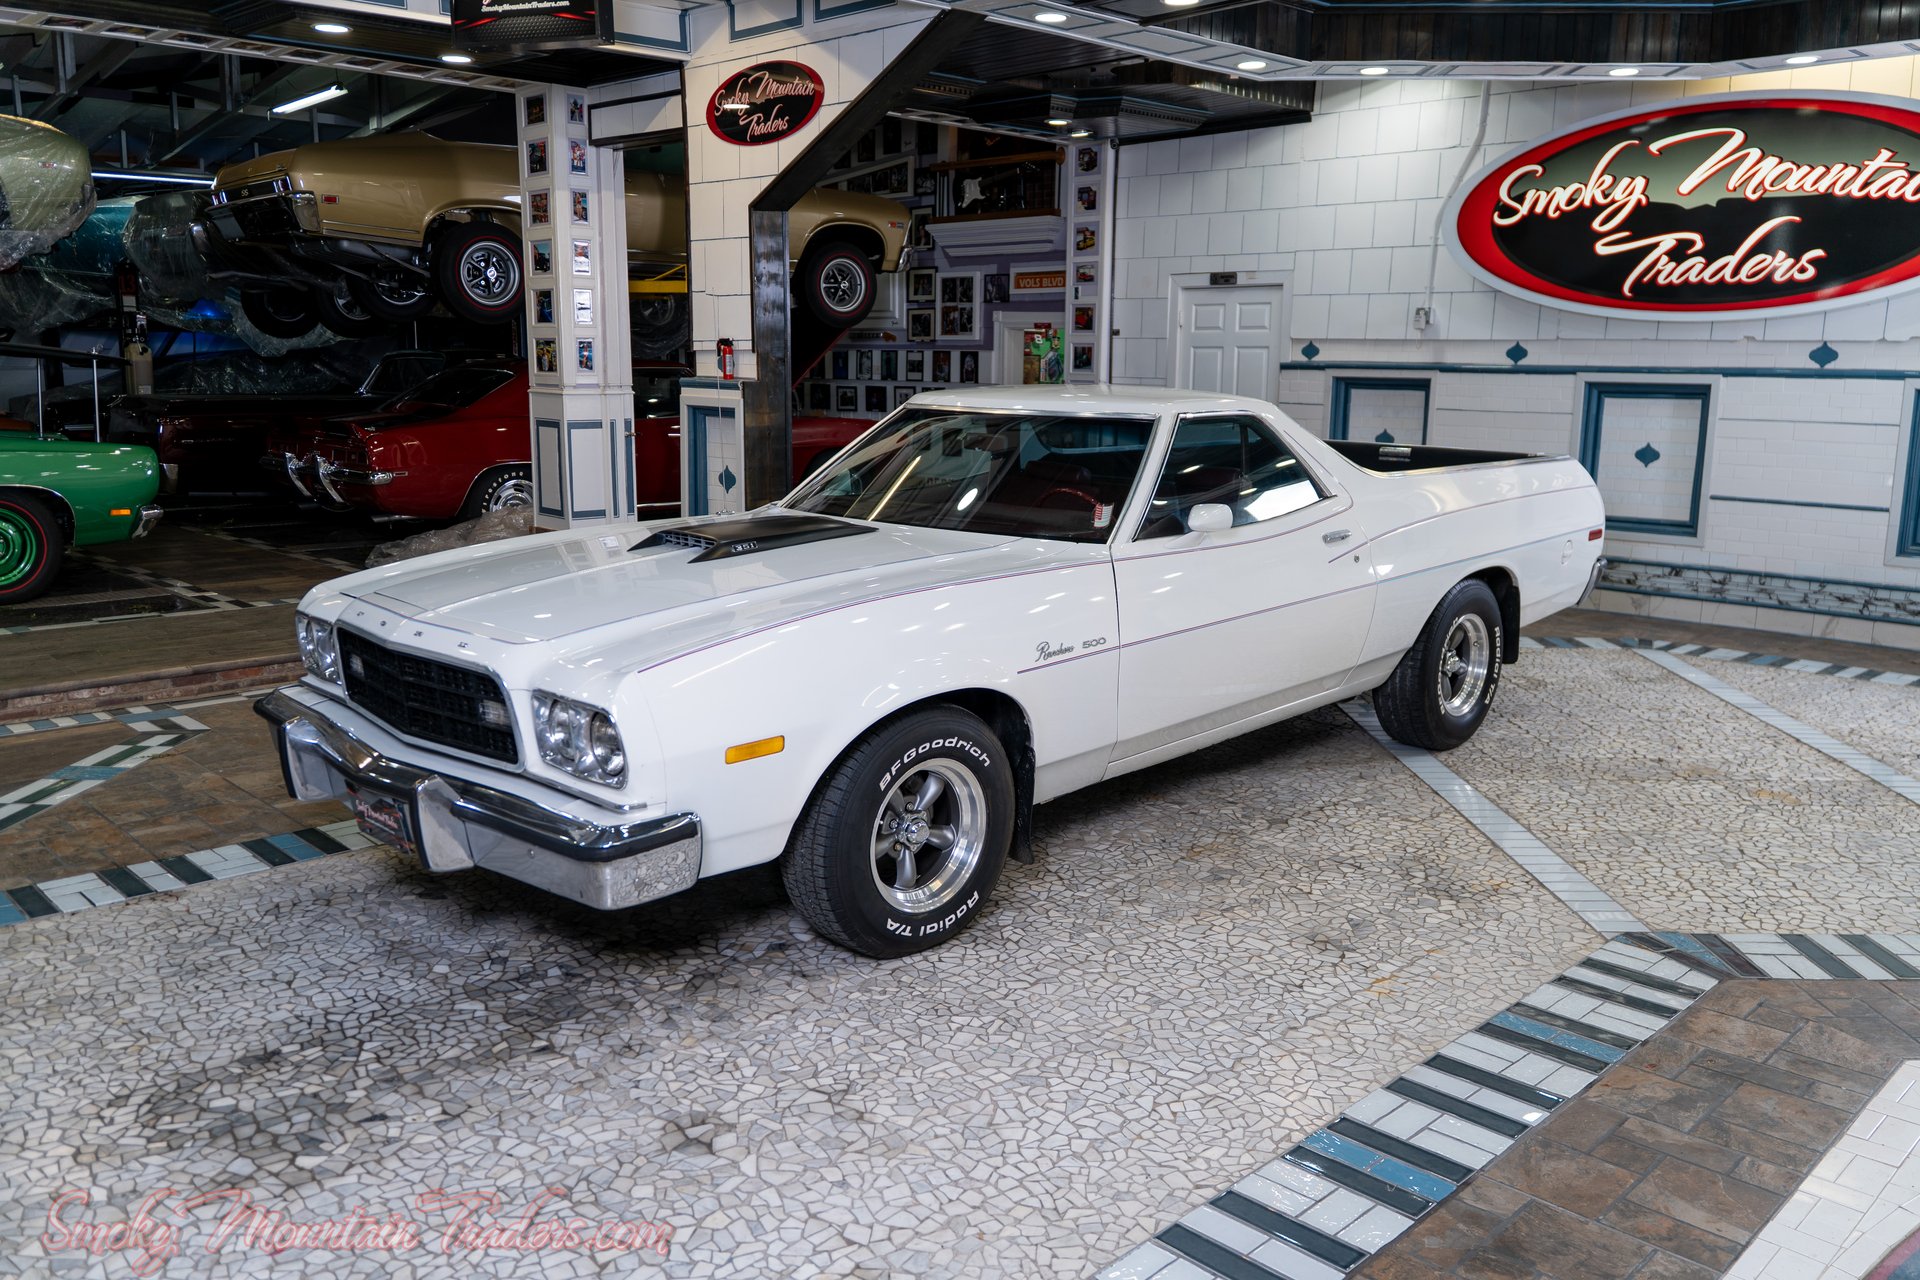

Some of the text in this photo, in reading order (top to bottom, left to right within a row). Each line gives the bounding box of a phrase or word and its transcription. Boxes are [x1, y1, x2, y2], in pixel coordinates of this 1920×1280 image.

[481, 1, 570, 12] SmokyMountainTraders.com
[748, 70, 815, 99] Mountain
[739, 104, 790, 142] Traders
[1492, 138, 1648, 233] Smoky
[1594, 214, 1828, 298] Traders
[1019, 277, 1064, 288] VOLS BLVD
[734, 541, 756, 552] 351
[1082, 637, 1107, 649] 500
[1492, 625, 1502, 679] Radial
[879, 737, 991, 792] BFGoodrich
[886, 890, 980, 937] Radial T/A
